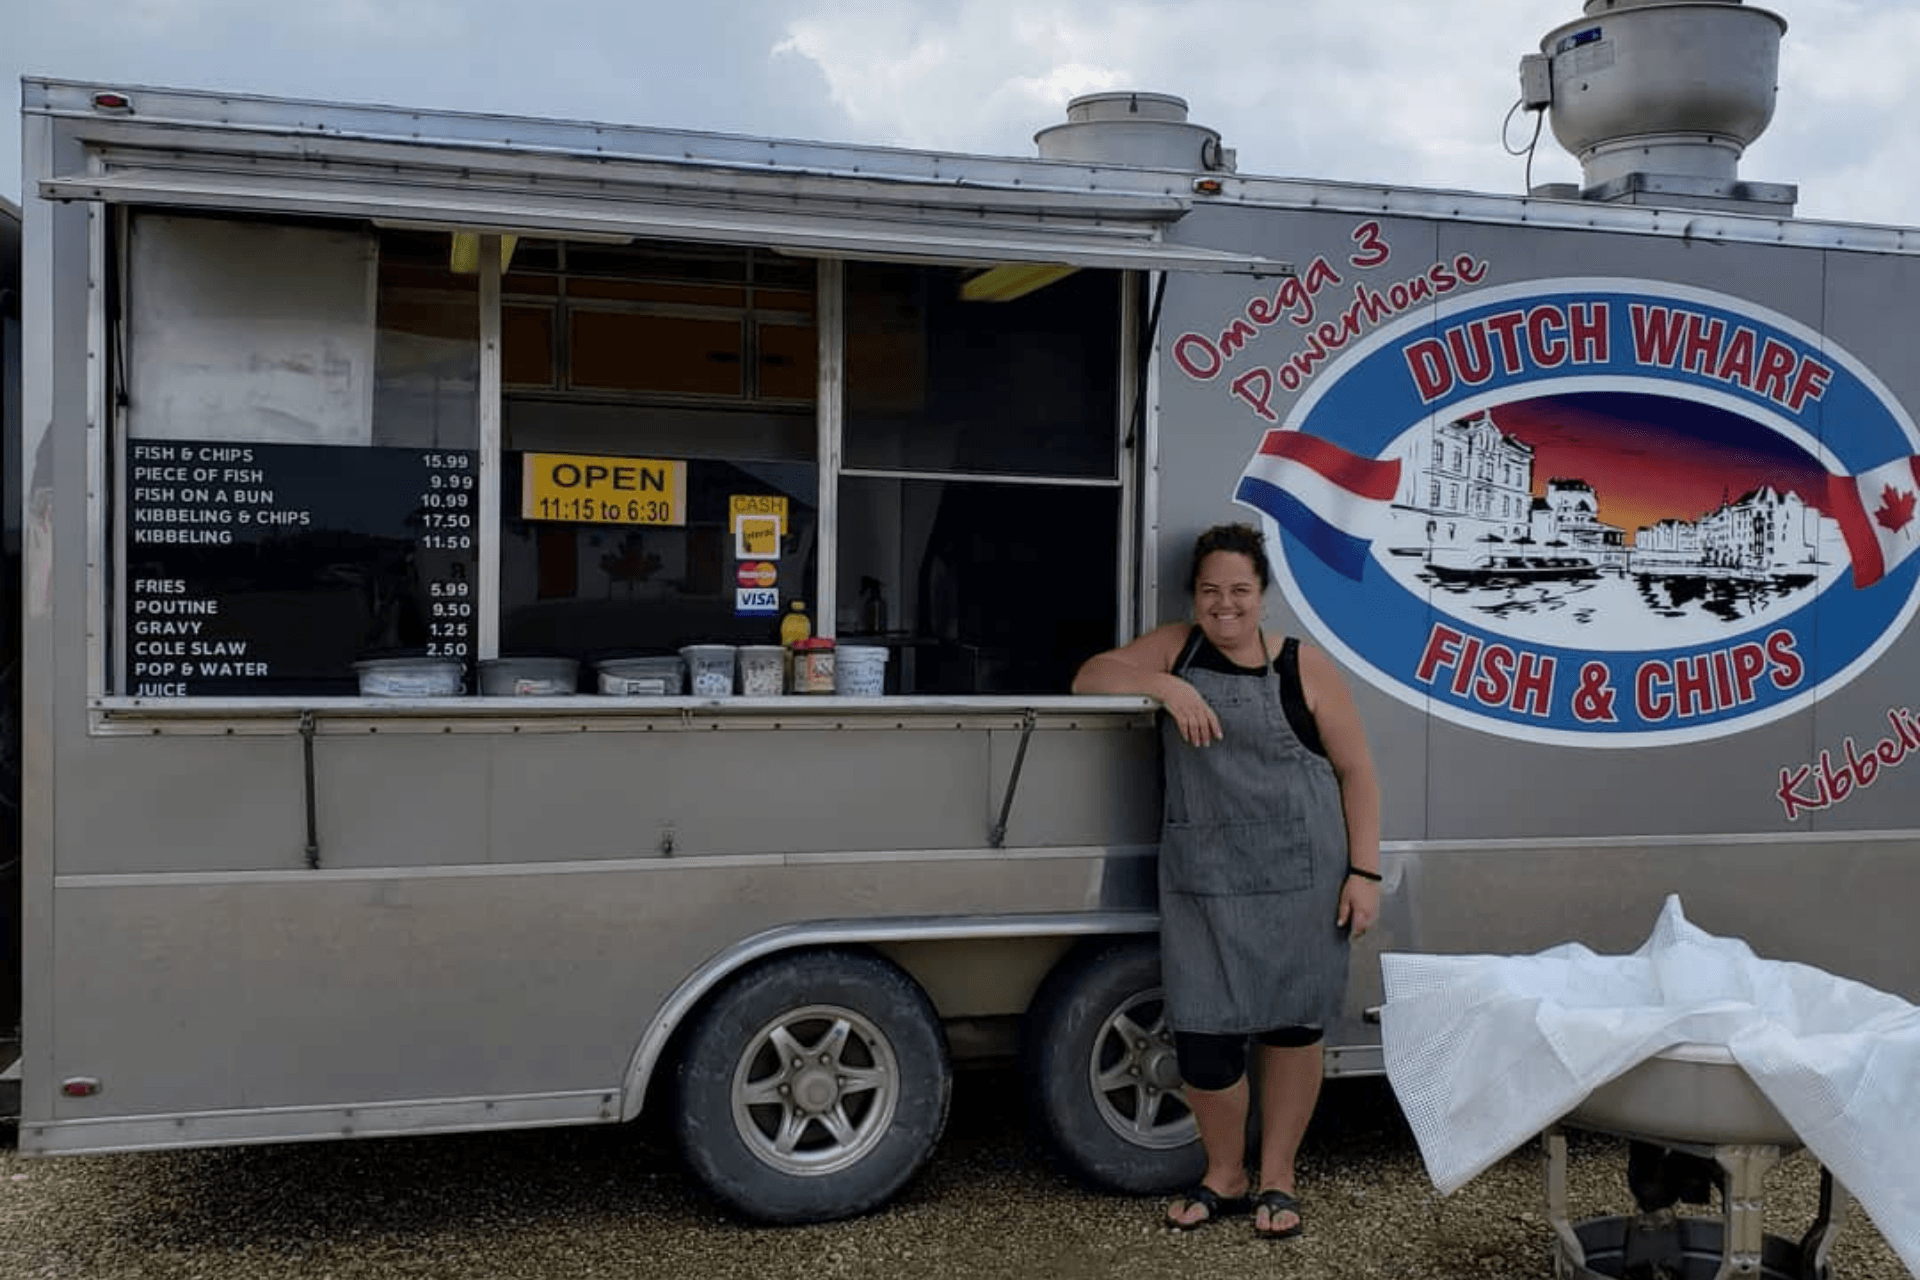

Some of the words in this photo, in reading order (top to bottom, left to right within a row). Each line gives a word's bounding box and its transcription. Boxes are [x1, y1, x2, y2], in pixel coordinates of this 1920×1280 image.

[1172, 257, 1343, 380] Omega
[1350, 220, 1391, 267] 3
[1231, 254, 1488, 422] Powerhouse
[1402, 303, 1610, 405] DUTCH
[1628, 303, 1833, 415] WHARF
[134, 445, 175, 460] FISH
[180, 447, 194, 461] &
[198, 447, 254, 463] CHIPS
[423, 454, 468, 469] 15.99
[134, 466, 188, 482] PIECE
[193, 467, 219, 482] OF
[223, 468, 263, 483] FISH
[430, 474, 473, 490] 9.99
[551, 463, 666, 493] OPEN
[134, 487, 175, 502] FISH
[180, 488, 209, 503] ON
[214, 489, 229, 503] A
[234, 489, 273, 504] BUN
[421, 493, 468, 508] 10.99
[733, 497, 784, 513] CASH
[135, 508, 232, 524] KIBBELING
[238, 510, 251, 524] &
[256, 510, 310, 525] CHIPS
[423, 513, 471, 528] 17.50
[539, 496, 595, 521] 11:15
[601, 499, 622, 521] to
[627, 501, 670, 523] 6:30
[135, 529, 232, 544] KIBBELING
[423, 535, 471, 549] 11.50
[135, 579, 186, 594] FRIES
[430, 582, 469, 597] 5.99
[135, 600, 218, 615] POUTINE
[433, 602, 471, 617] 9.50
[742, 593, 776, 606] VISA
[135, 621, 202, 635] GRAVY
[430, 623, 468, 637] 1.25
[135, 641, 186, 656] COLE
[191, 641, 247, 656] SLAW
[426, 642, 467, 656] 2.50
[135, 662, 175, 676] POP
[181, 662, 194, 676] &
[199, 662, 268, 676] WATER
[1414, 622, 1558, 718] FISH
[1571, 660, 1619, 723] &
[1634, 628, 1805, 720] CHIPS
[134, 682, 188, 698] JUICE
[1776, 707, 1920, 821] Kibbeli
